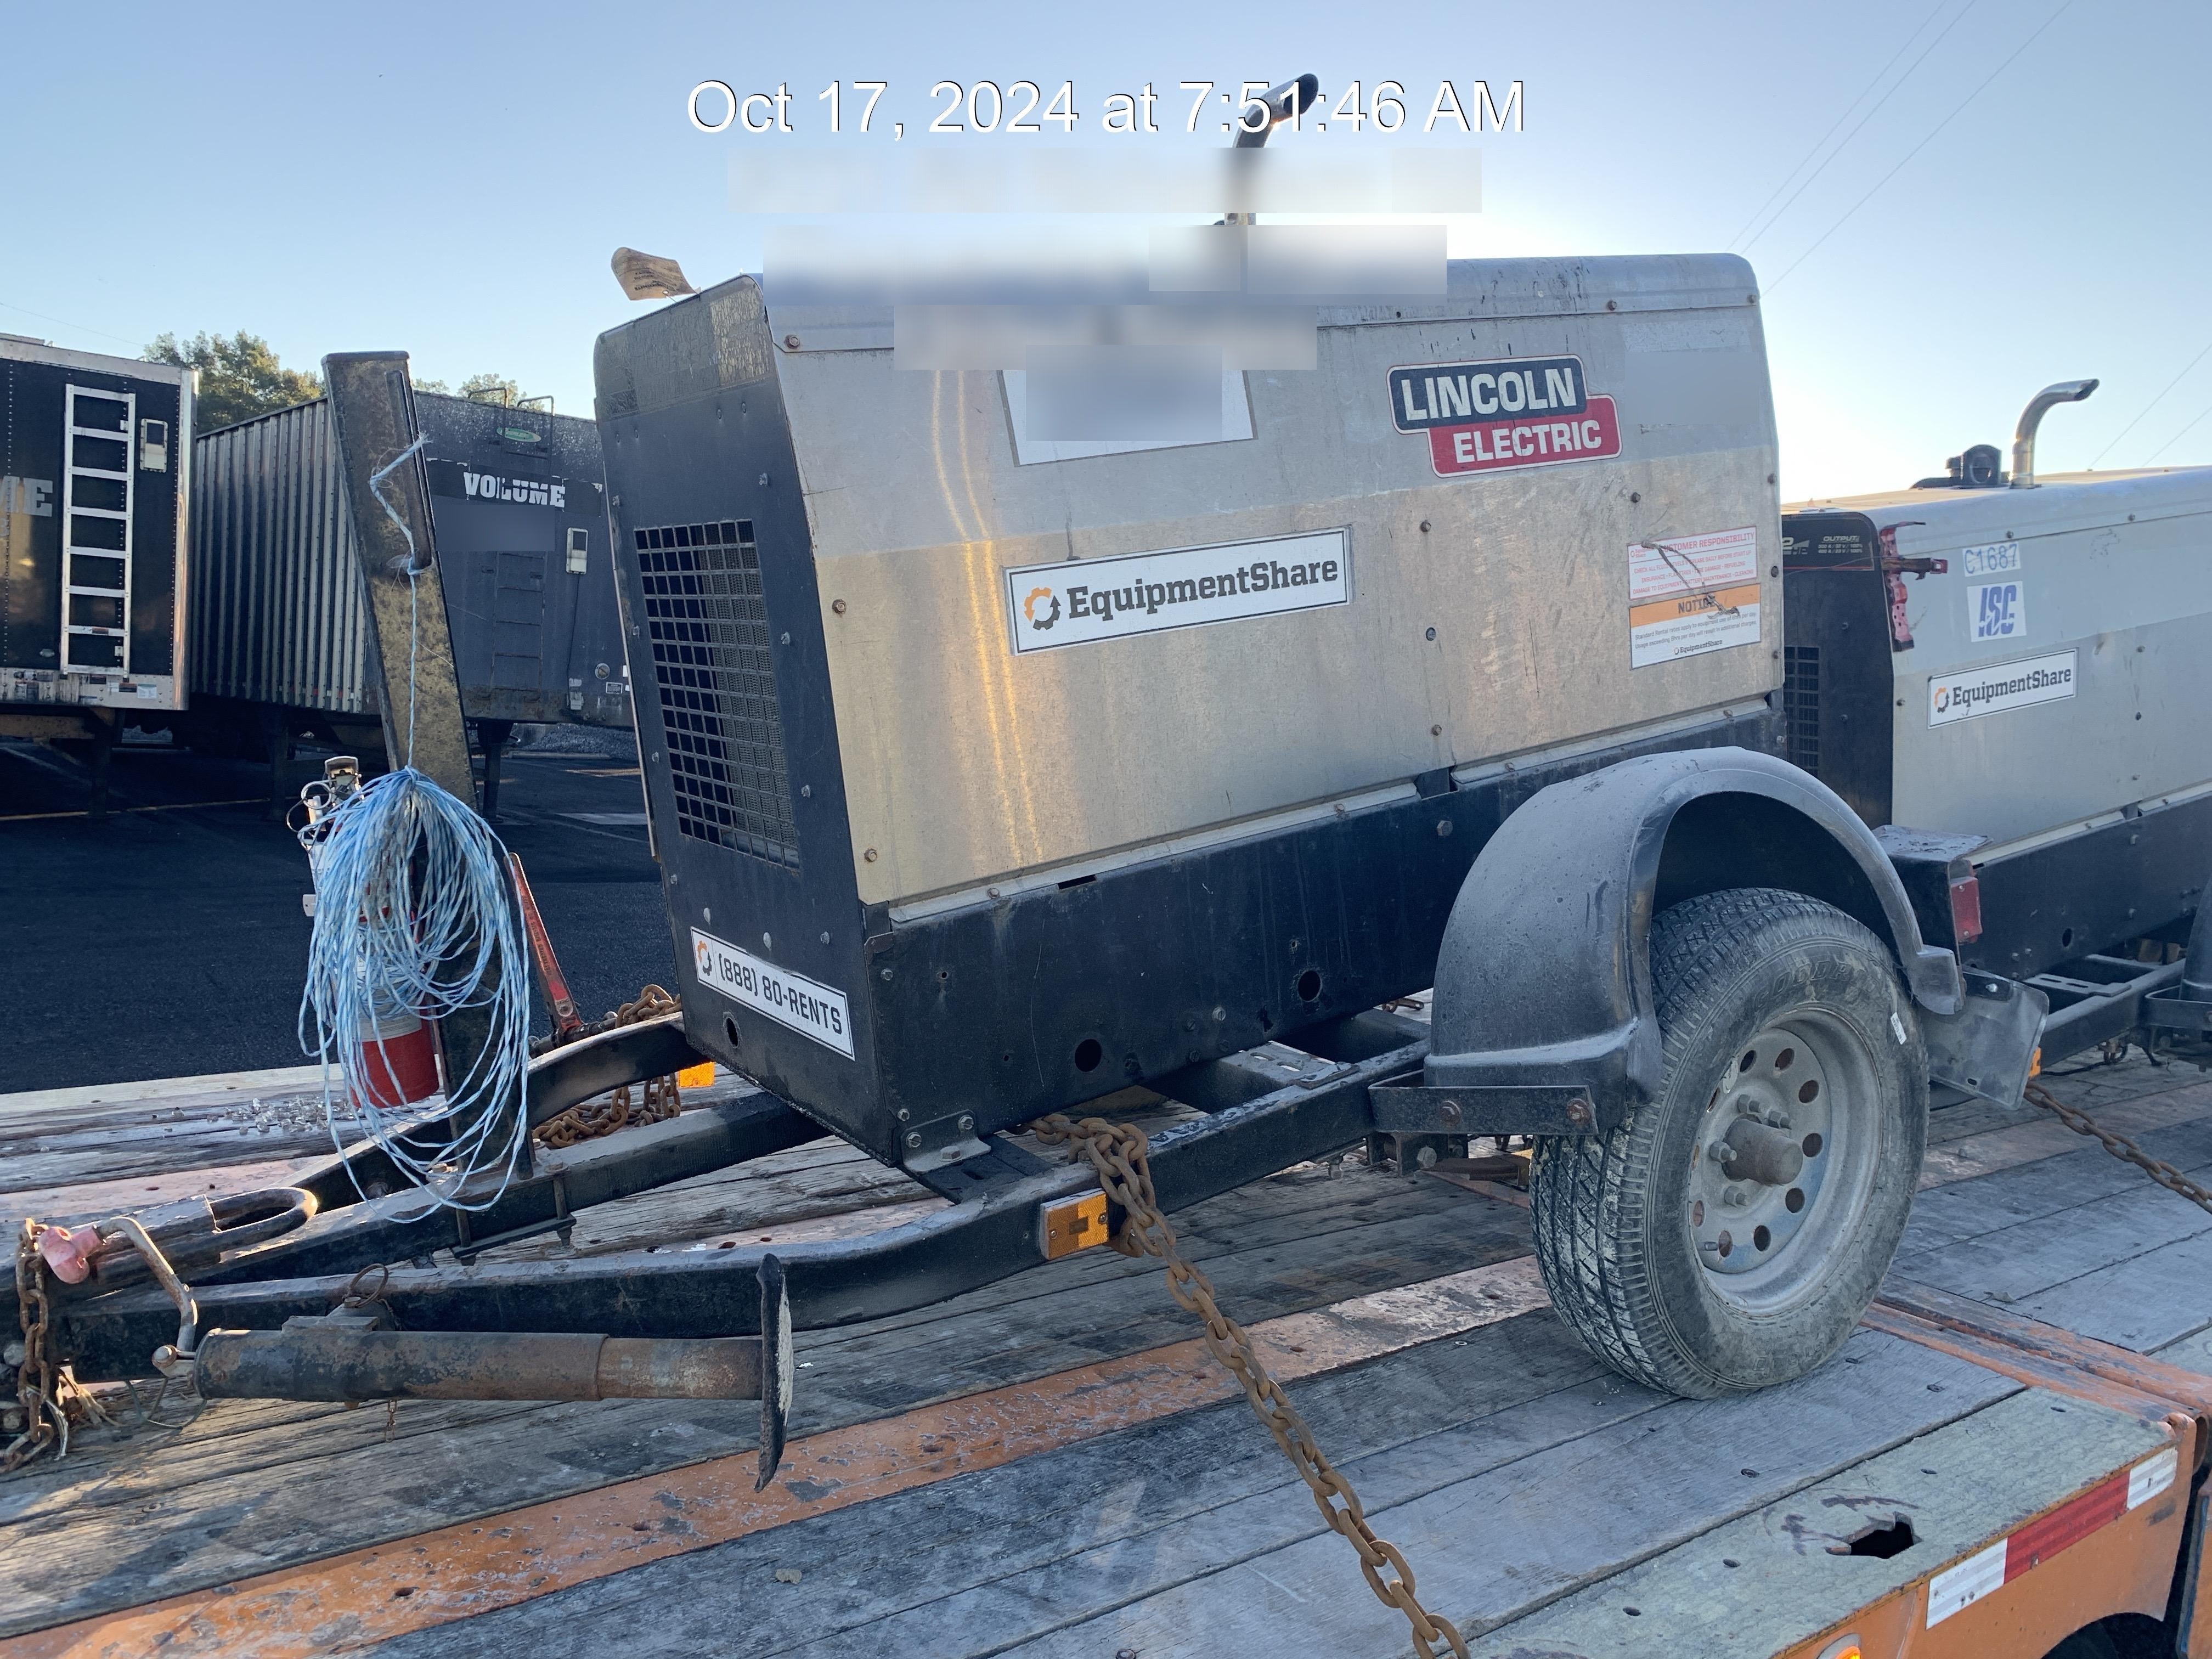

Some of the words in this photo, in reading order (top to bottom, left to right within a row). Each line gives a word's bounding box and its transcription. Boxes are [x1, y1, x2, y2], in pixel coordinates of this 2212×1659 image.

[1401, 367, 1577, 421] LINCOLN
[1452, 419, 1602, 464] ELECTRIC
[463, 471, 566, 508] VOLUME
[1699, 531, 1754, 548] RESPONSIBILITY
[1641, 573, 1665, 583] INSURANCE
[1725, 560, 1745, 568] REFUELING
[1965, 544, 2017, 574] C1687
[1066, 559, 1338, 621] EquipmentShare
[1657, 580, 1681, 590] EQUIPMENT
[1703, 572, 1731, 582] MAINTENANCE
[1735, 568, 1753, 577] CLEANING
[1978, 584, 2017, 637] ISC
[1635, 631, 1654, 640] Standard
[1681, 623, 1691, 631] apply
[1697, 618, 1718, 628] equipment
[1635, 641, 1648, 650] Usage
[1649, 637, 1670, 647] exceeding
[1680, 640, 1722, 654] EquipmentShare
[1952, 667, 2072, 708] EquipmentShare
[718, 952, 759, 997] (888)
[762, 975, 843, 1035] 80-RENTS
